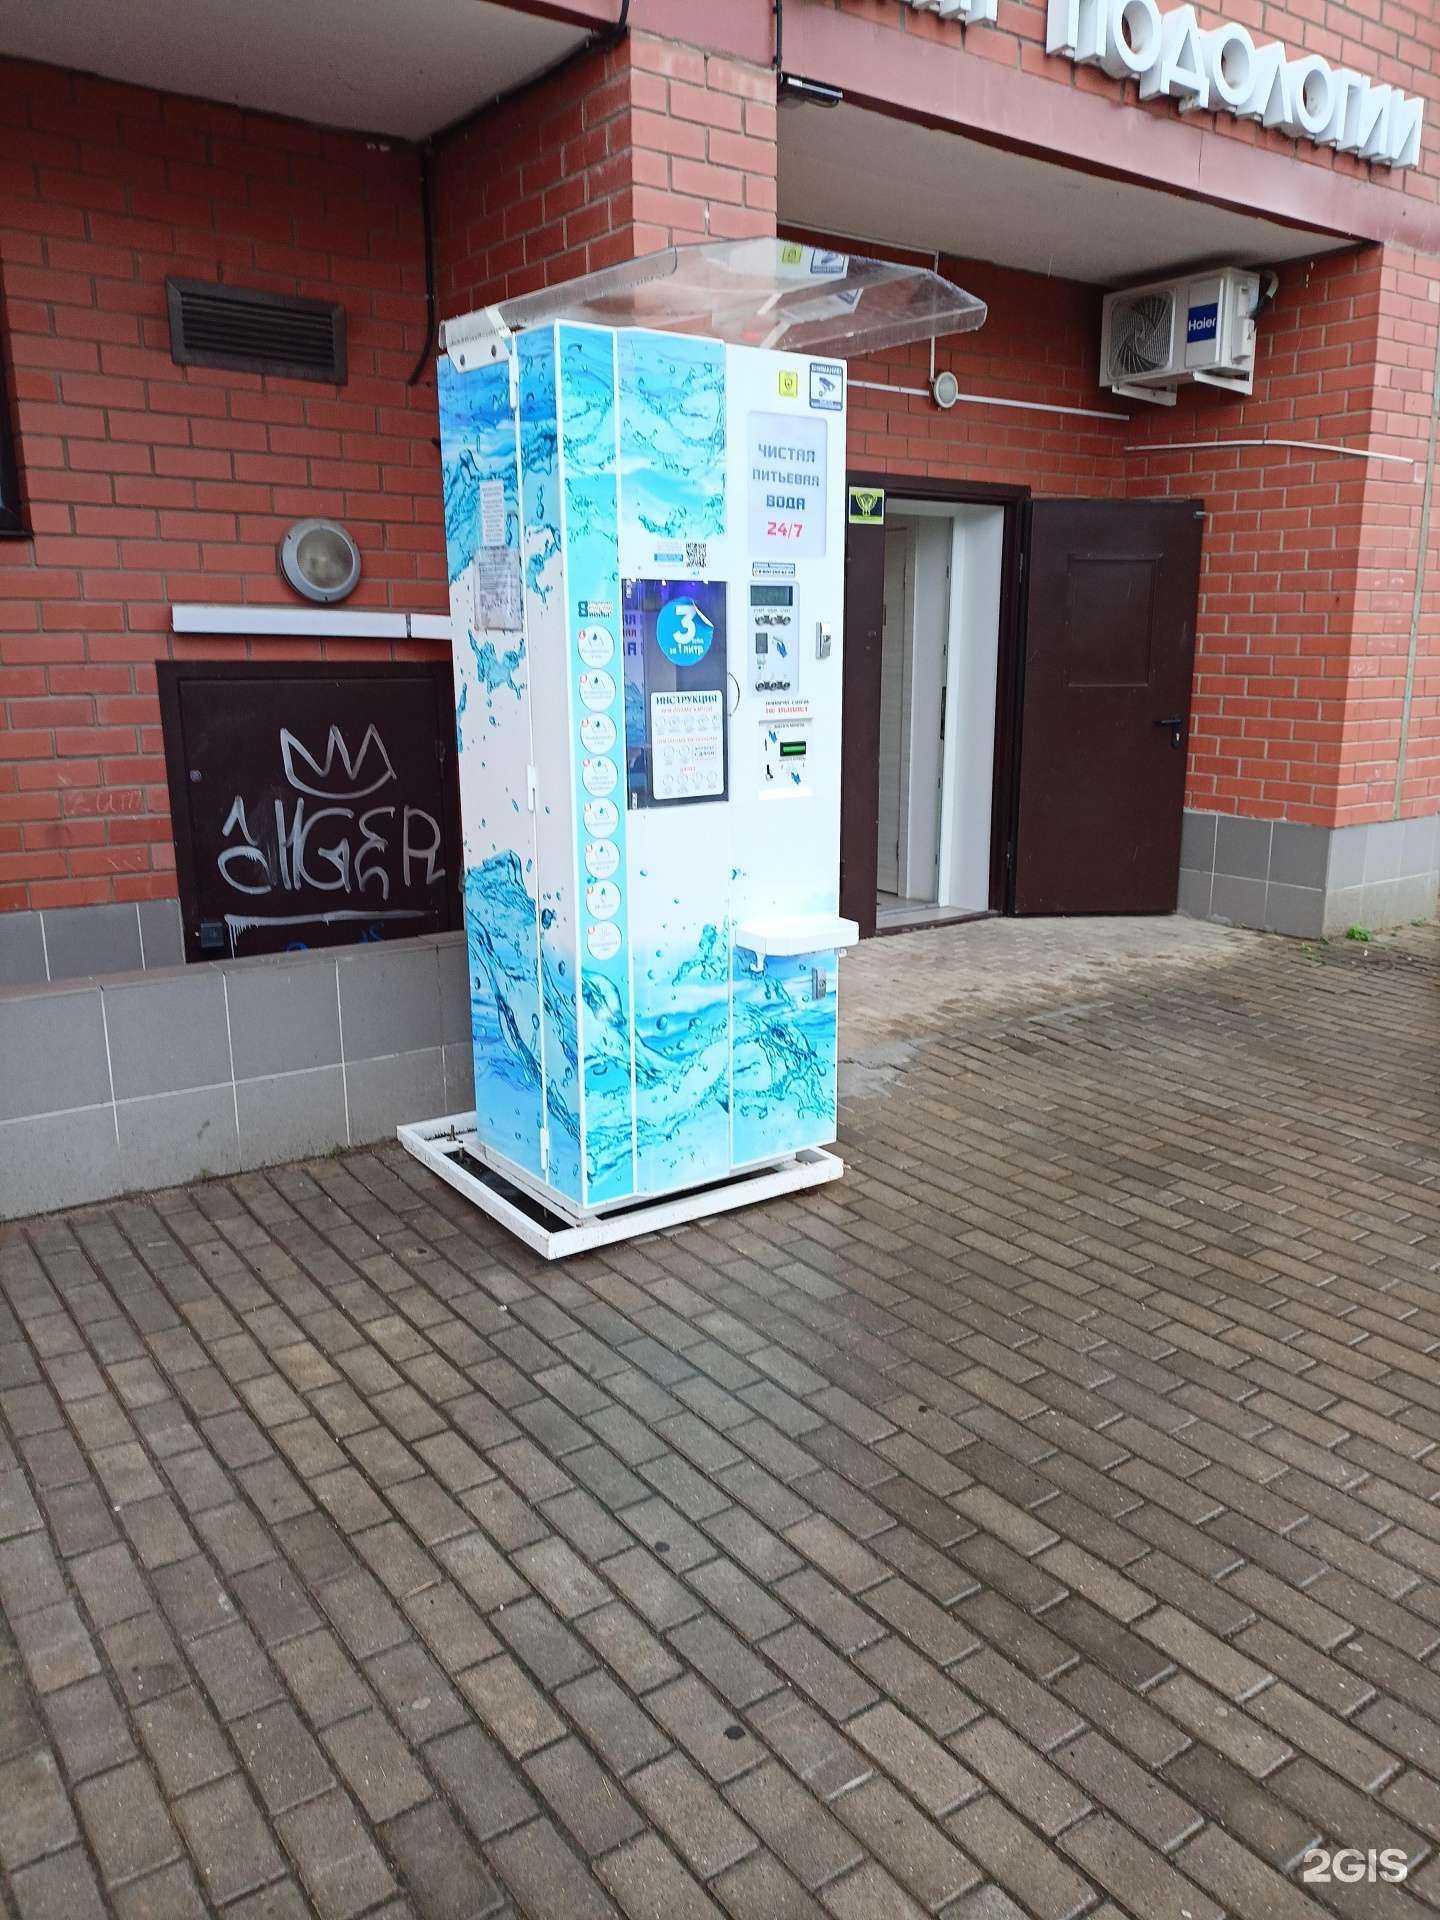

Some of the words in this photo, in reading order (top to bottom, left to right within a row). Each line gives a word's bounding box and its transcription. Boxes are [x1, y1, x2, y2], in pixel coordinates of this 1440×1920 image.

[1046, 0, 1424, 168] ПОДОЛОГИИ
[1188, 316, 1216, 331] Haier
[758, 443, 815, 462] ЧИСТАЯ
[753, 468, 819, 486] ПИТЬЕВАЯ
[766, 494, 805, 510] ВОДА
[767, 521, 802, 540] 24/7
[672, 604, 697, 645] 3
